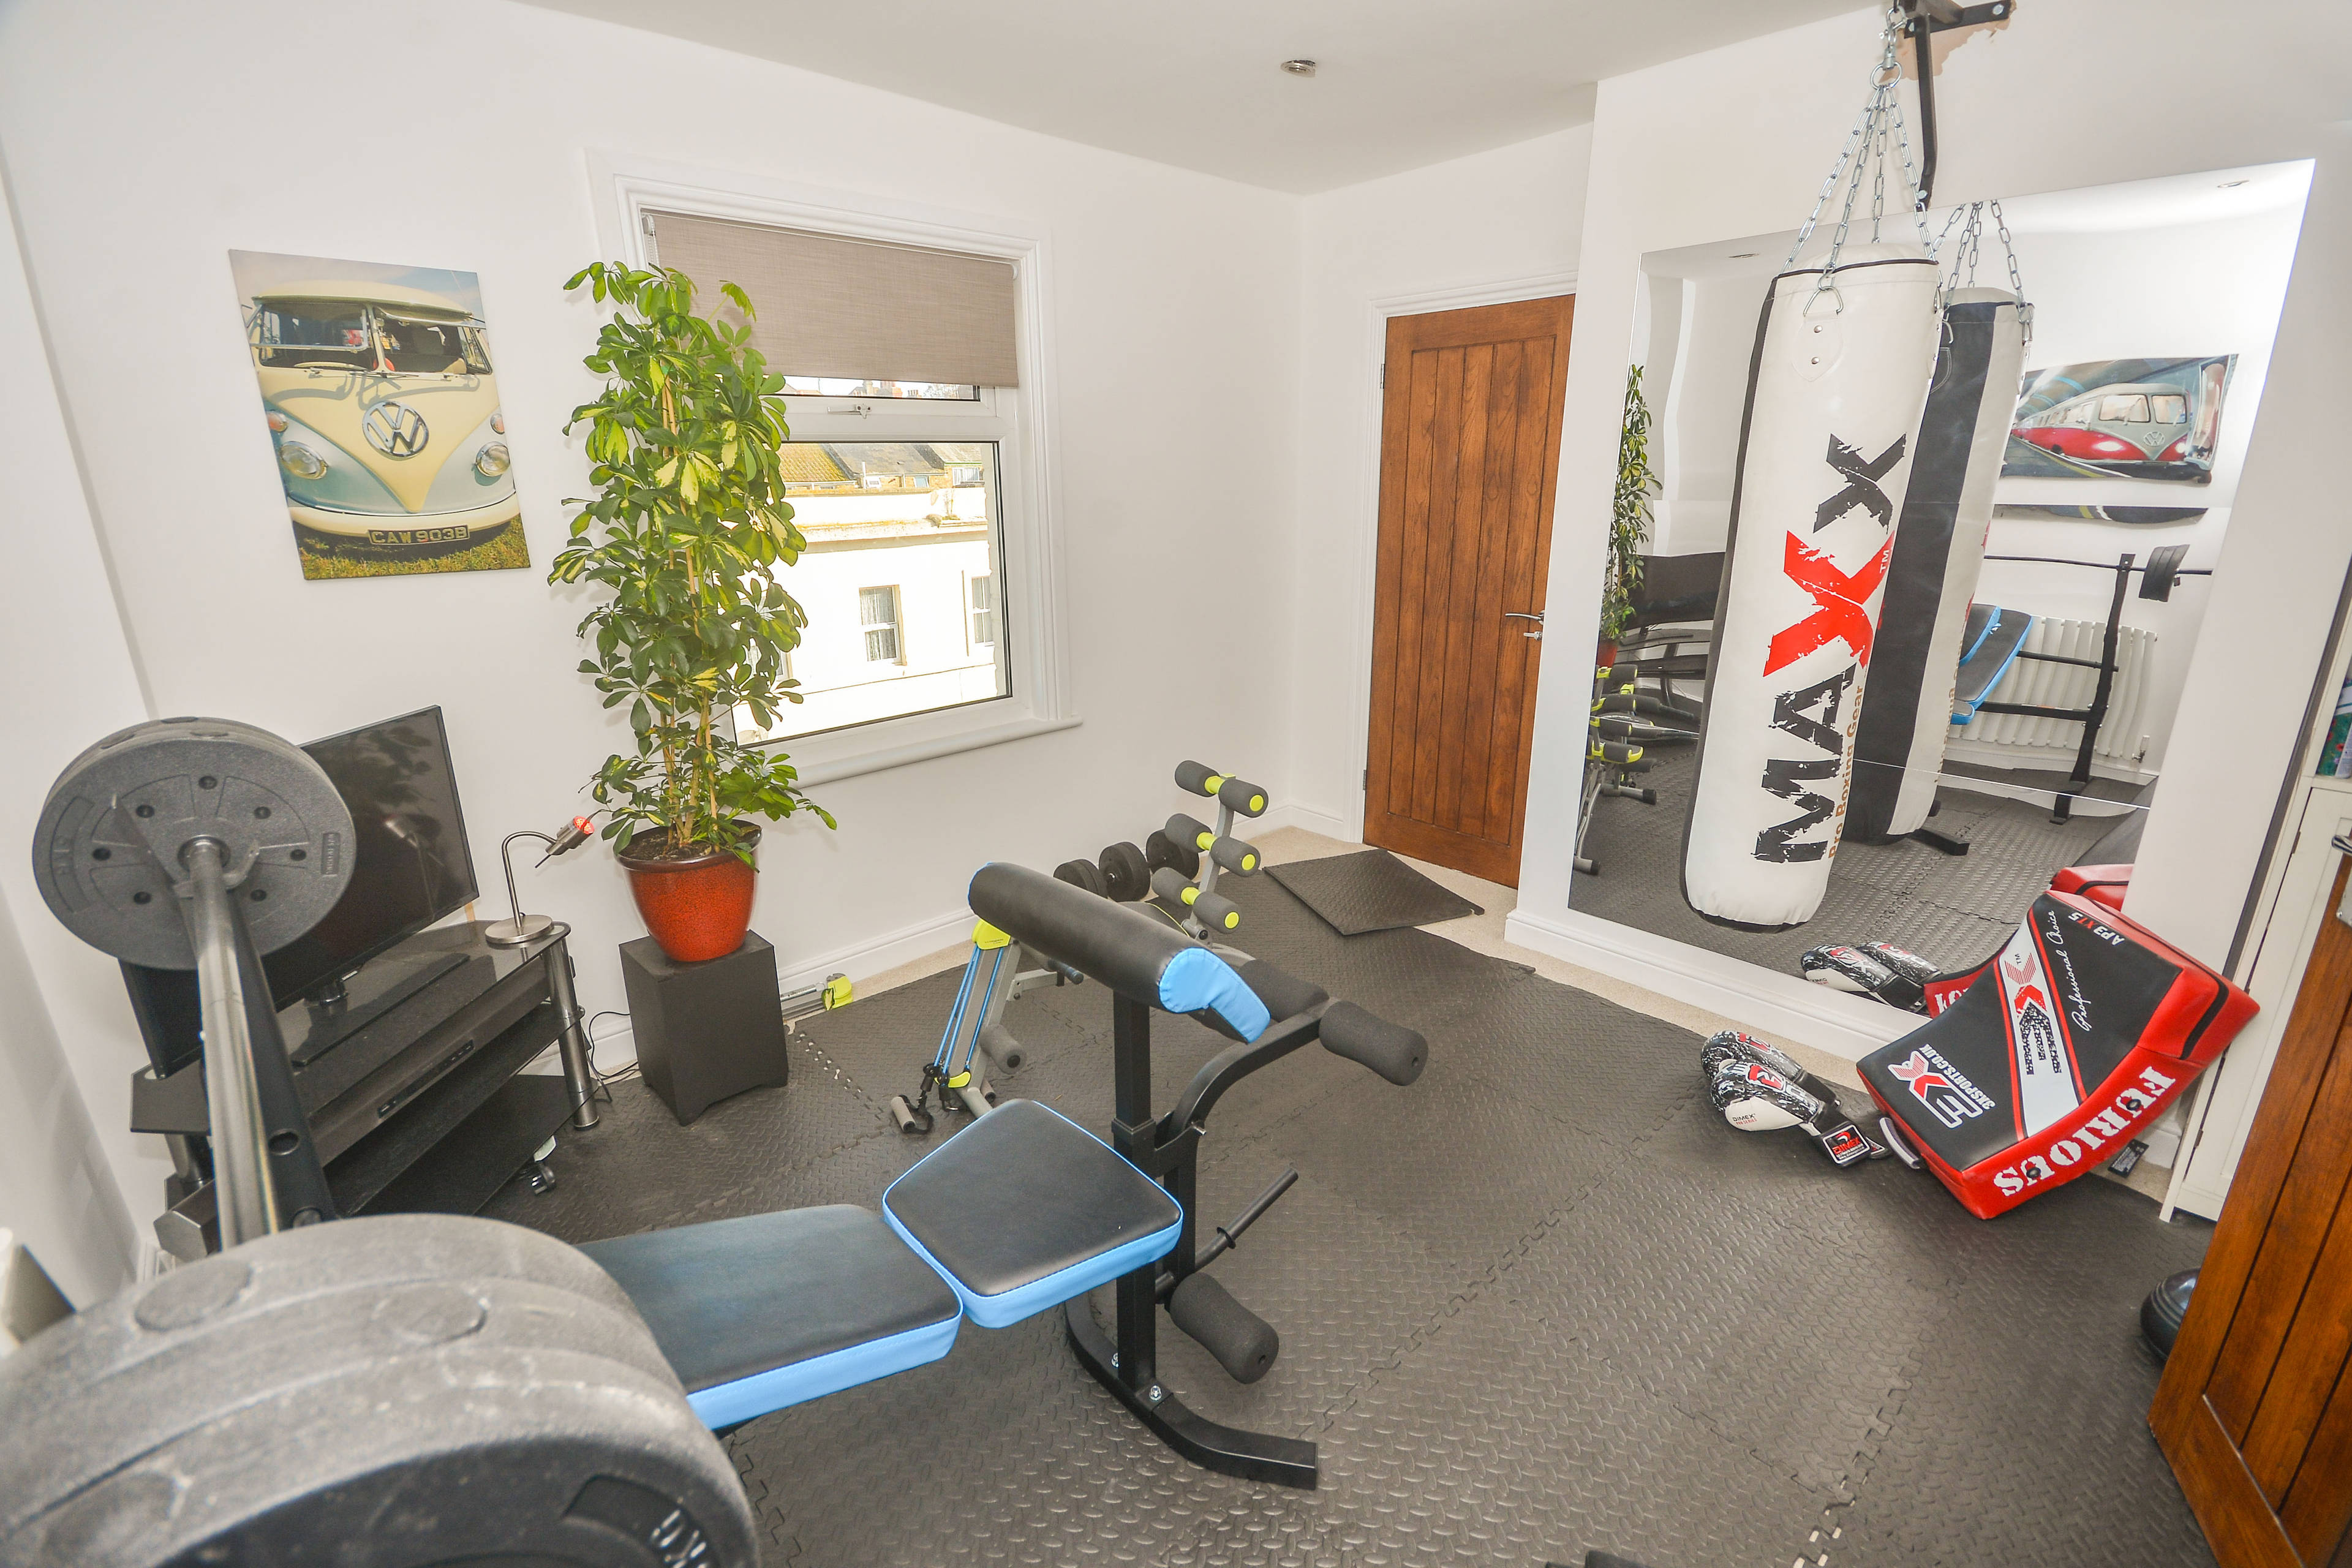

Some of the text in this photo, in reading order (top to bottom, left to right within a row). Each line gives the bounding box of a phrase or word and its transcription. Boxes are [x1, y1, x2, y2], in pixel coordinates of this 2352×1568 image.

[371, 526, 467, 544] CAW 903B
[1751, 432, 1906, 863] MAXX
[1847, 685, 1863, 738] Gear
[2046, 910, 2092, 1032] Professional Choice
[1732, 1114, 1755, 1122] DIMEX
[1993, 1066, 2176, 1197] FURIOUS
[1832, 1137, 1861, 1155] DIMEX
